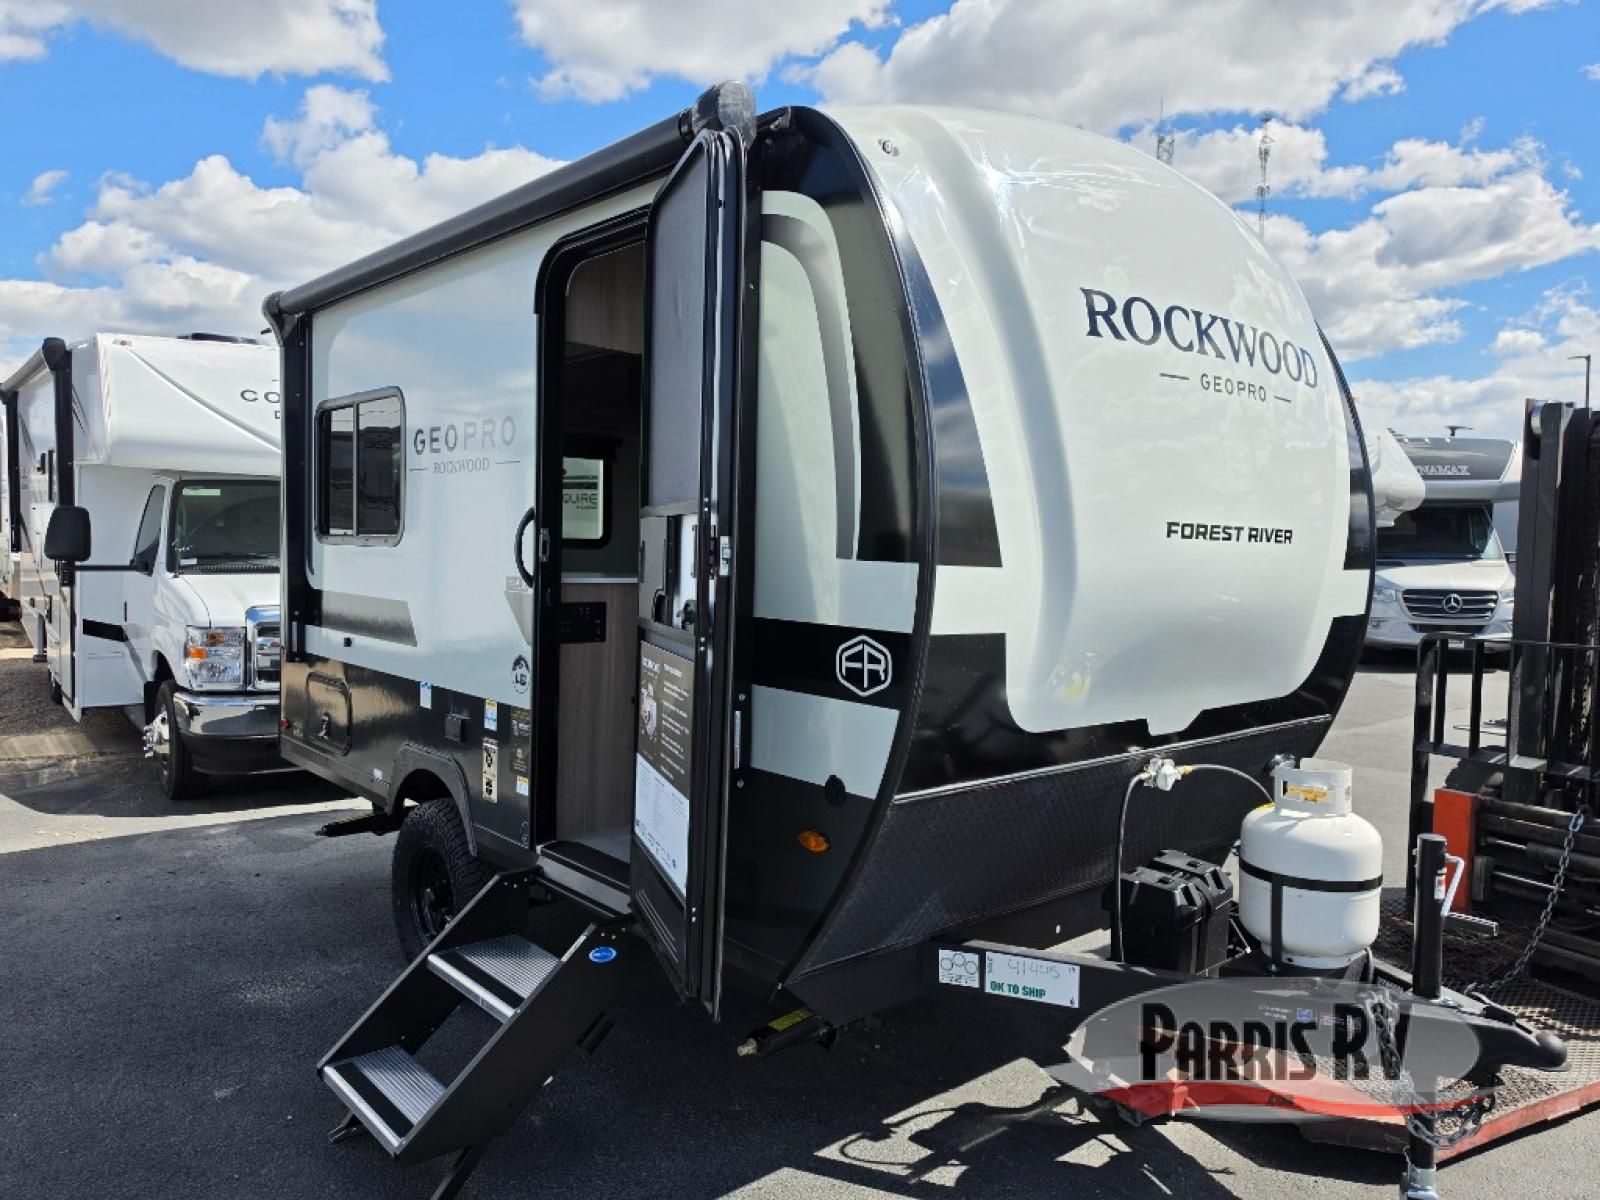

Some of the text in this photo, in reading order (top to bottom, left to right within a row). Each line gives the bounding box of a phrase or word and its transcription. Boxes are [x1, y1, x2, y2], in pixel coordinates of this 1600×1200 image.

[1080, 287, 1318, 388] ROCKWOOD
[1200, 373, 1267, 402] GEOPRO
[413, 415, 516, 455] GEOPRO
[433, 457, 490, 475] ROCKWOOD
[1166, 521, 1293, 544] FOREST RIVER
[990, 980, 1046, 999] OK TO SHIP
